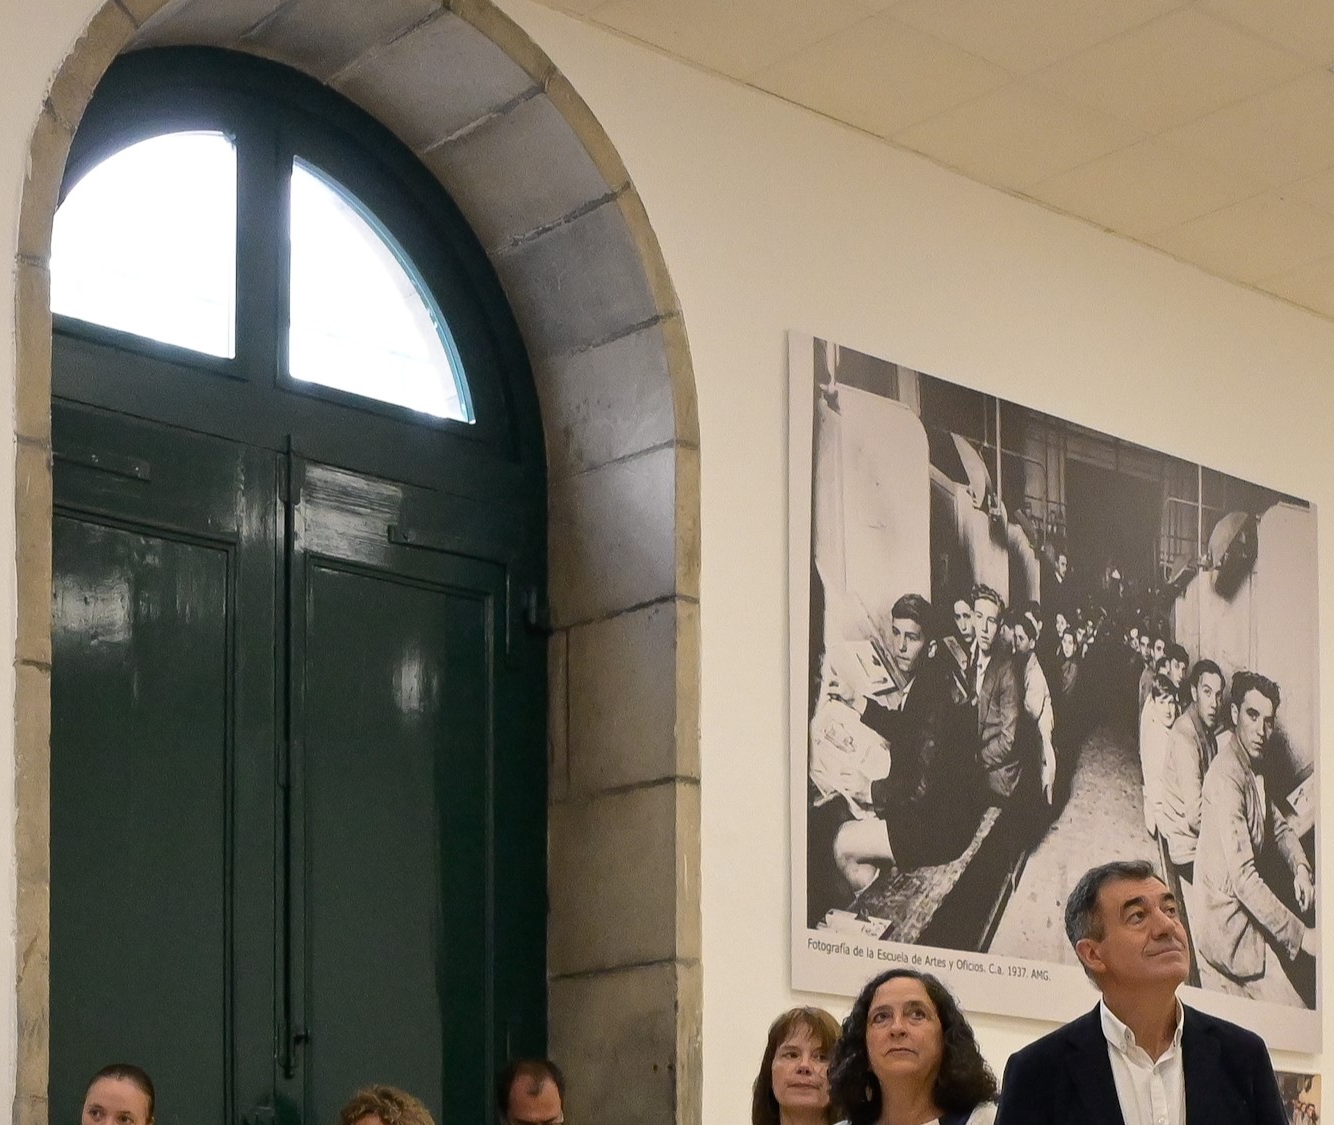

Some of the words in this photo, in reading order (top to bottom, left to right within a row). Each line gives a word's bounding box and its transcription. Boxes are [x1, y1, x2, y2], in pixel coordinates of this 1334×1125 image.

[807, 938, 850, 955] Fotografía
[853, 945, 864, 957] de
[866, 947, 874, 959] la
[877, 948, 909, 963] Escuela
[911, 953, 923, 965] de
[925, 955, 947, 968] Artes
[956, 959, 986, 973] Oficios.
[1007, 965, 1028, 979] 1937.
[1030, 968, 1052, 981] AMG.
